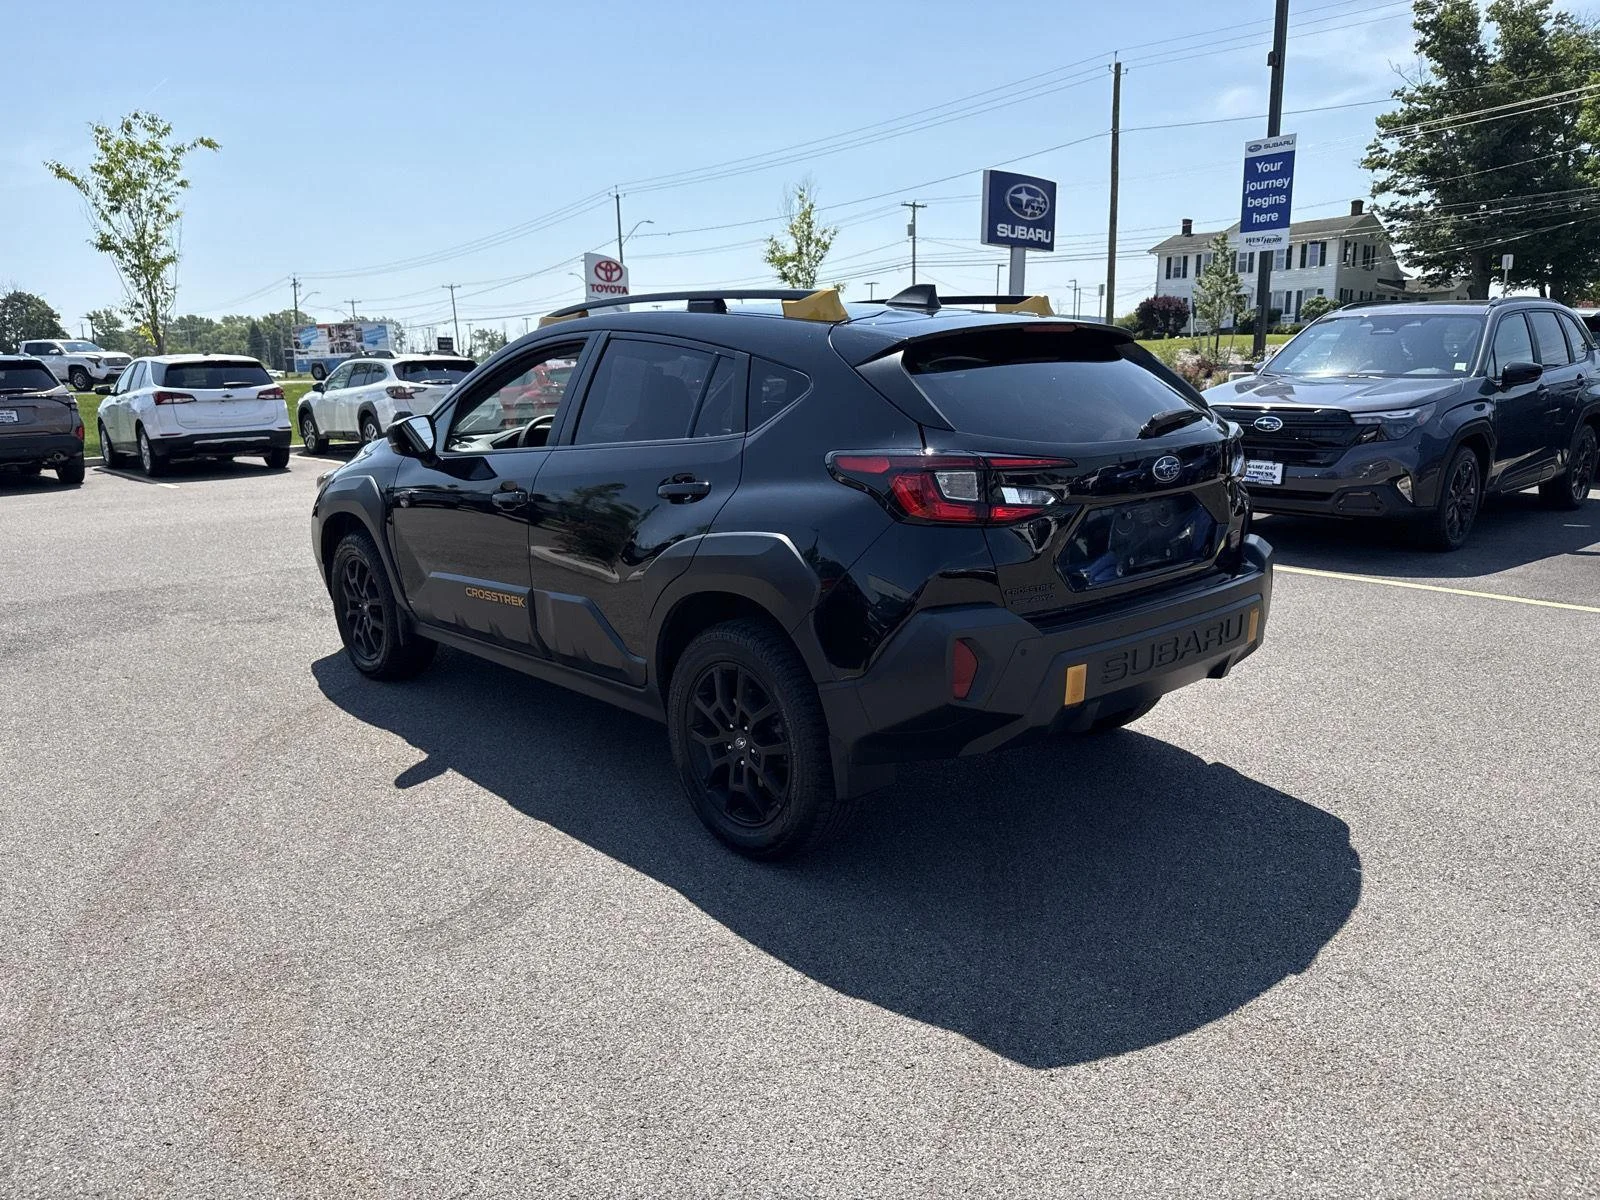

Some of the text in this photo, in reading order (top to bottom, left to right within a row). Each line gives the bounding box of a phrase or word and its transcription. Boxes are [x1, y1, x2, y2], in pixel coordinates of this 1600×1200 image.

[1263, 140, 1294, 149] SUBARU
[1256, 161, 1283, 173] Your
[1245, 177, 1290, 193] journey
[1247, 194, 1286, 208] begins
[1252, 212, 1279, 224] here
[996, 223, 1052, 244] SUBARU
[590, 284, 629, 295] TOYOTA
[465, 587, 526, 608] CROSSTREK
[1102, 613, 1243, 684] SUBARU
